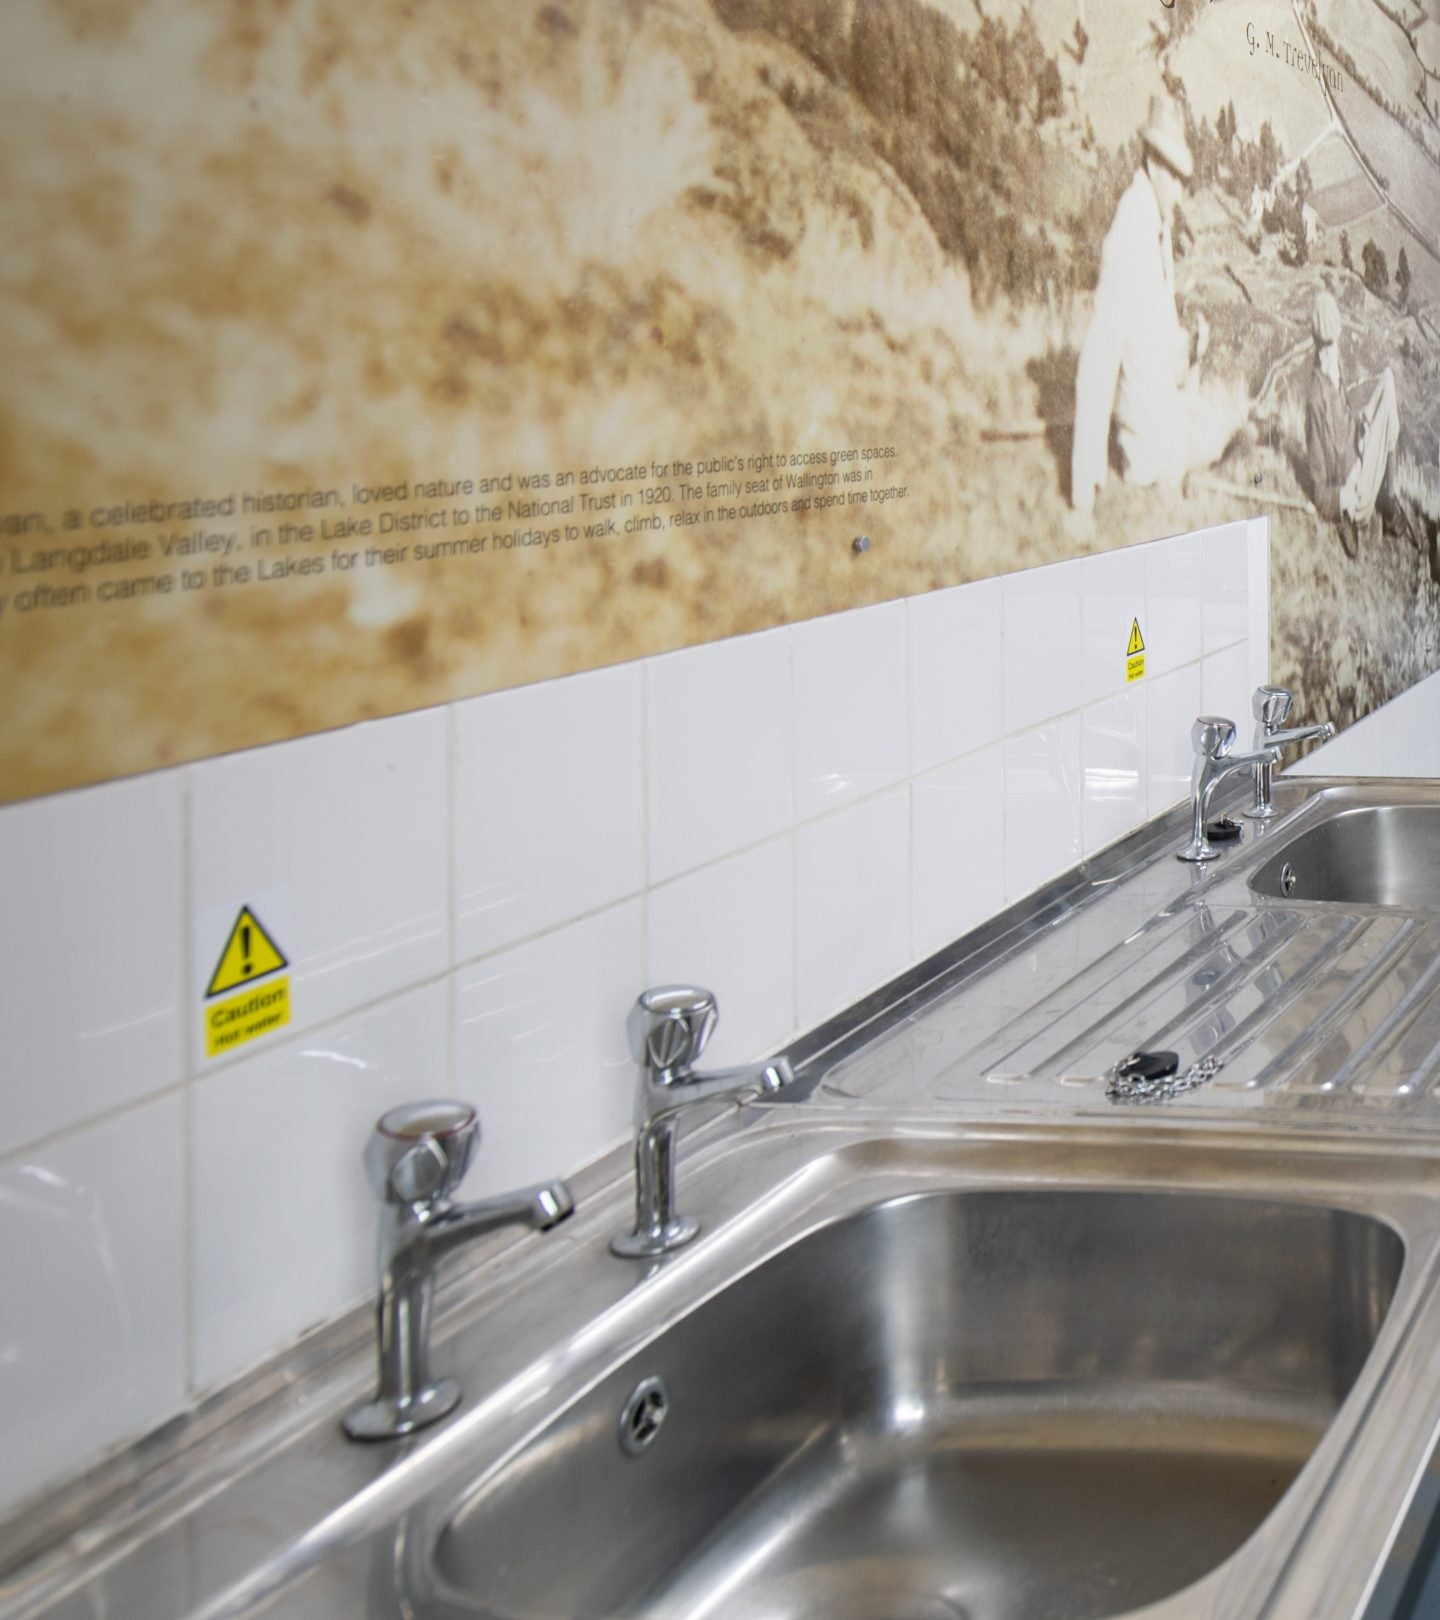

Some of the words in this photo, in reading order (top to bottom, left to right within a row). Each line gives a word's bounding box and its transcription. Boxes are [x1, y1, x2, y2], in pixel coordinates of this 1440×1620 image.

[1246, 22, 1260, 56] G.
[1265, 31, 1280, 59] M.
[1283, 41, 1343, 97] Trevelyan
[11, 537, 149, 574] Langdale
[157, 530, 243, 557] Valley,
[251, 526, 272, 547] in
[278, 522, 314, 545] the
[320, 516, 372, 541] Lake
[379, 508, 447, 534] District
[453, 508, 470, 527] to
[475, 504, 502, 524] the
[507, 496, 574, 521] National
[579, 493, 616, 512] Trust
[620, 491, 632, 507] in
[639, 485, 674, 506] 1920.
[679, 483, 703, 501] The
[706, 479, 742, 499] family
[745, 477, 769, 494] seat
[772, 475, 783, 491] of
[786, 471, 840, 489] Wallington
[842, 470, 862, 483] was
[864, 468, 873, 481] in
[62, 508, 83, 531] a
[90, 494, 237, 529] celebrated
[242, 488, 343, 514] historian,
[352, 481, 408, 505] loved
[414, 477, 473, 498] nature
[479, 472, 512, 494] and
[517, 473, 550, 490] was
[555, 470, 574, 487] an
[579, 464, 647, 485] advocate
[651, 460, 669, 479] for
[672, 459, 692, 477] the
[747, 454, 773, 474] right
[776, 454, 787, 468] to
[789, 452, 827, 466] access
[830, 449, 859, 466] green
[861, 446, 898, 462] spaces.
[14, 580, 92, 613] often
[96, 573, 174, 602] came
[181, 568, 207, 591] to
[212, 562, 249, 588] the
[257, 554, 325, 581] Lakes
[331, 550, 357, 572] for
[365, 542, 407, 568] their
[413, 535, 487, 561] summer
[492, 525, 560, 550] holidays
[565, 524, 579, 541] to
[583, 518, 620, 539] walk,
[624, 514, 665, 534] climb,
[670, 509, 700, 528] relax
[703, 507, 714, 523] in
[718, 504, 736, 521] the
[739, 499, 788, 519] outdoors
[791, 496, 811, 512] and
[814, 491, 845, 512] spend
[848, 490, 868, 505] time
[870, 485, 910, 504] together.
[210, 988, 286, 1029] Caution
[245, 1010, 283, 1035] water
